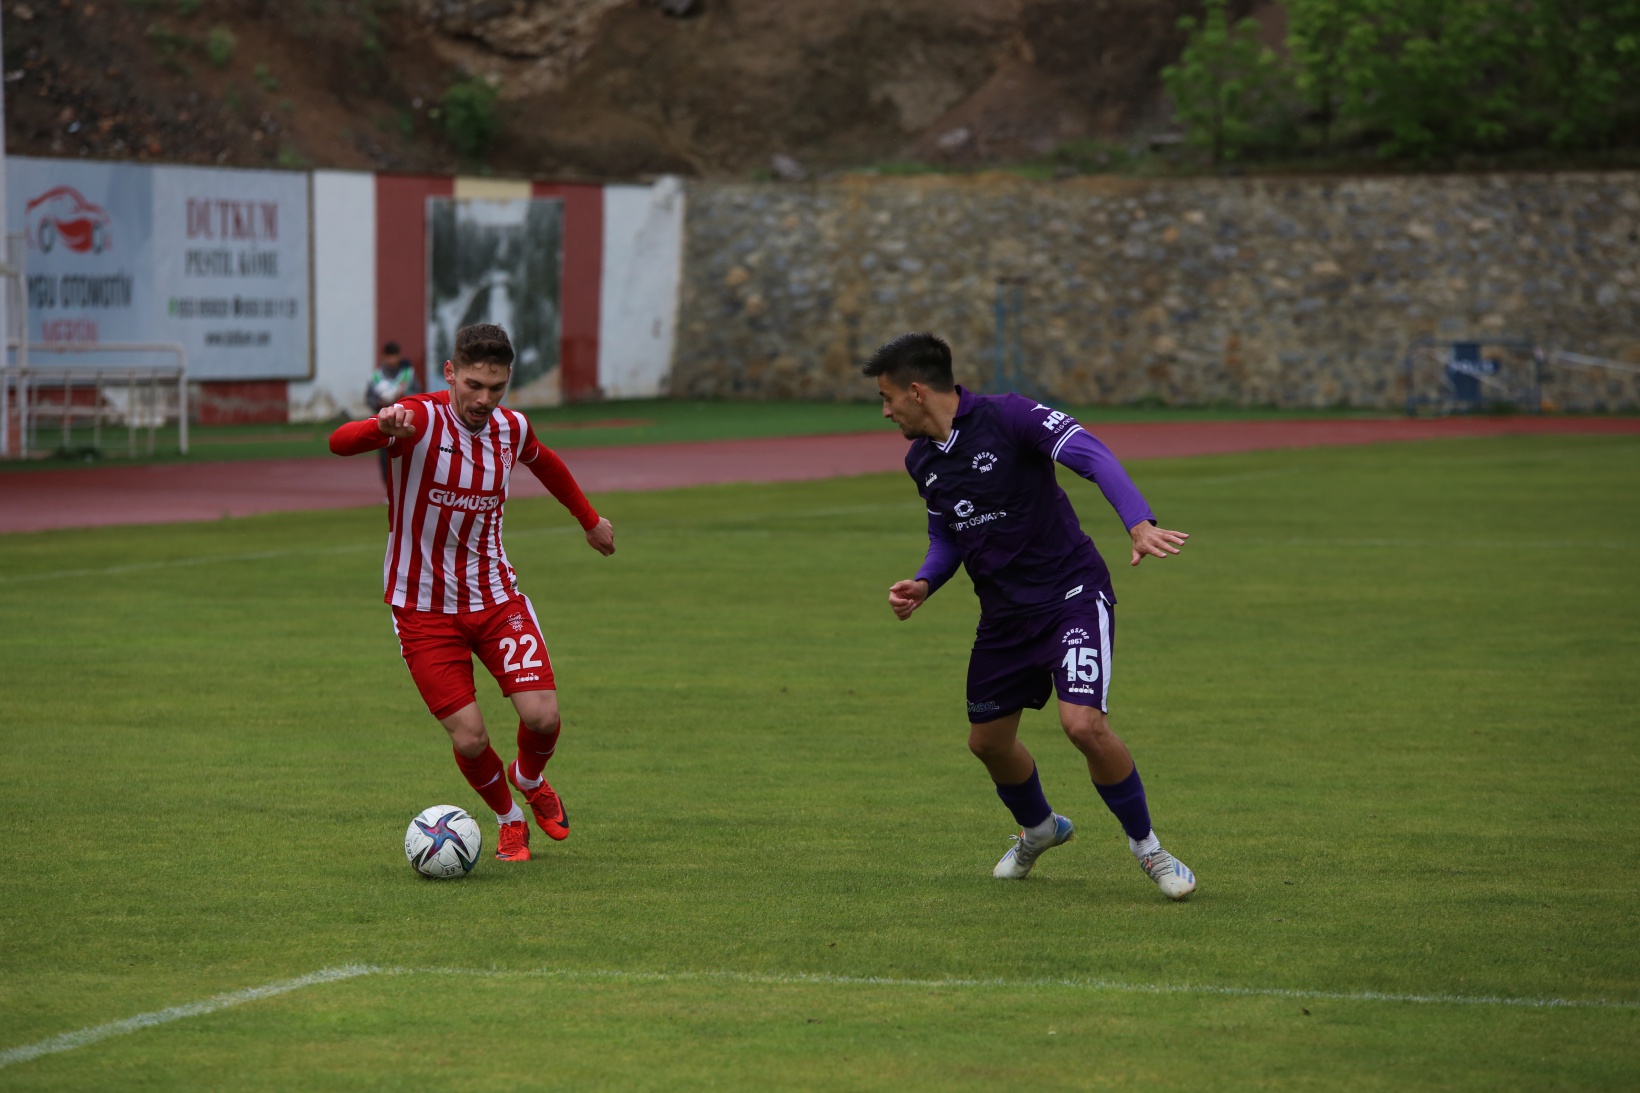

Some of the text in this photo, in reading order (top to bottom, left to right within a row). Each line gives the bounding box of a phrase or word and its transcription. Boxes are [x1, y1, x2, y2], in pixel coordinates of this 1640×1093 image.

[979, 463, 993, 474] 1967
[499, 634, 543, 673] 22
[1067, 638, 1083, 646] 1967
[1061, 647, 1100, 683] 15
